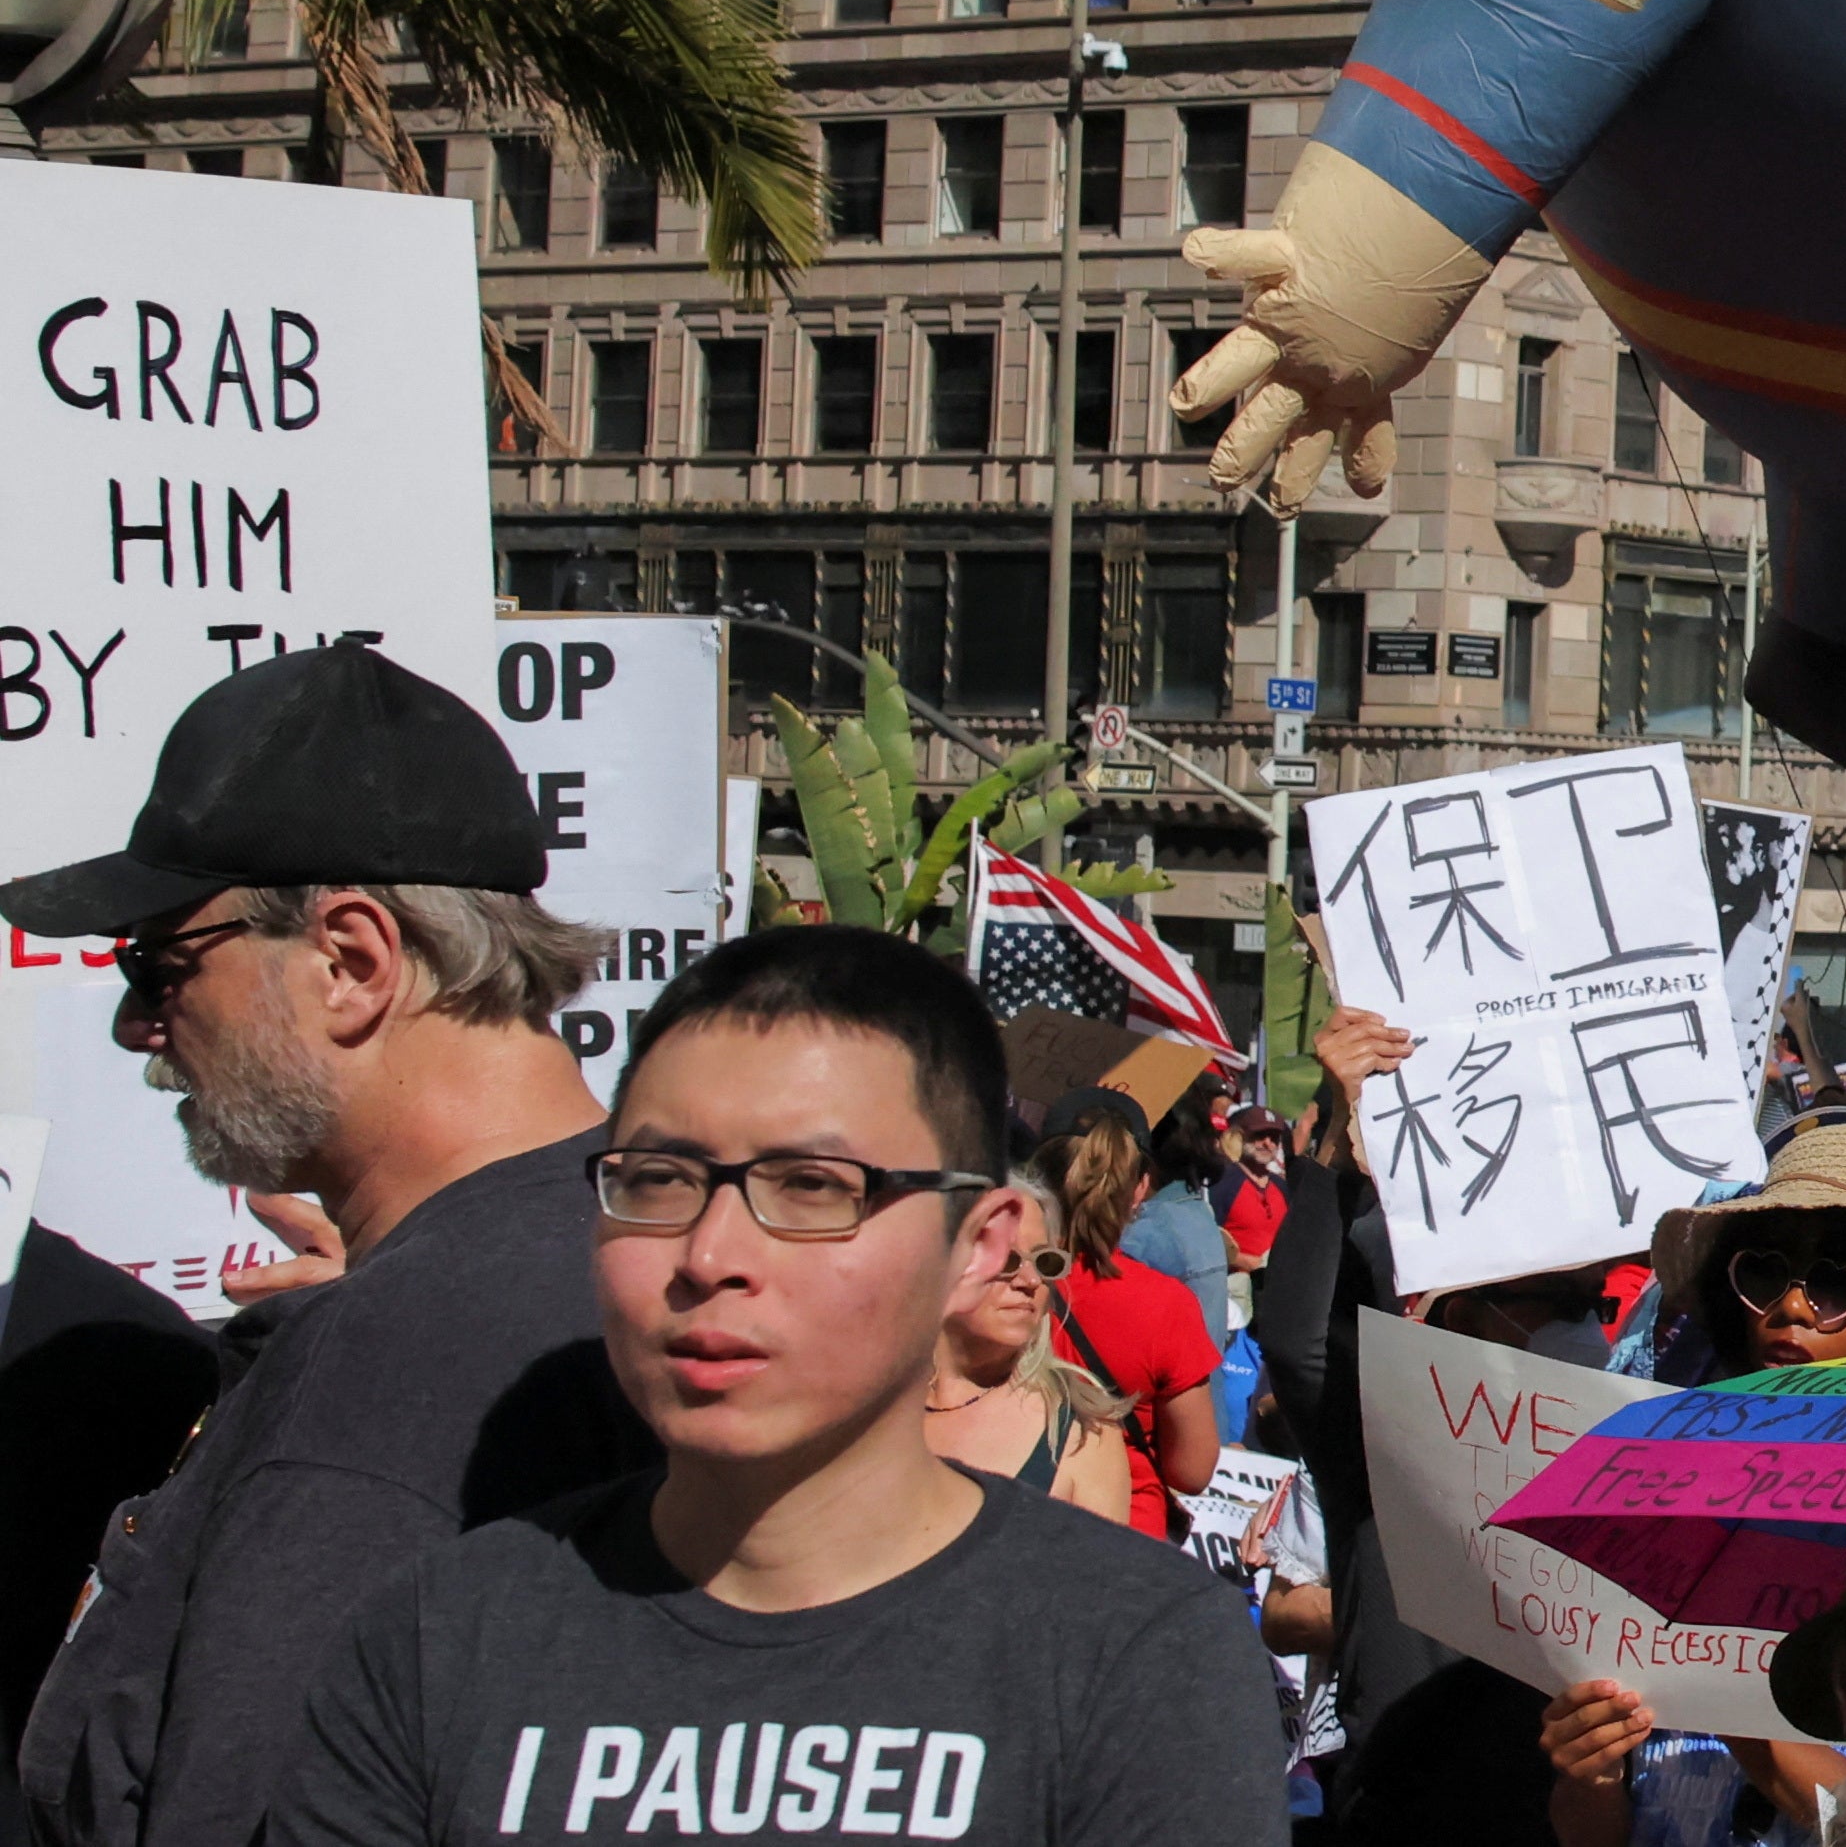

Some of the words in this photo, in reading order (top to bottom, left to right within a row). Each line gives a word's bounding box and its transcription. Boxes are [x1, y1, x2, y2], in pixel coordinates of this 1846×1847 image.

[38, 296, 320, 432] GRAB
[108, 477, 291, 593] HIM
[0, 625, 127, 741] BY
[1325, 764, 1719, 1004] 保卫
[1476, 991, 1557, 1020] PROTECT
[1565, 973, 1709, 1010] IMMIGRANTS
[1372, 999, 1739, 1234] 移民
[1429, 1361, 1578, 1458] WE
[1645, 1392, 1778, 1441] PBS
[1571, 1445, 1699, 1509] Free
[1460, 1524, 1517, 1580] WE
[1492, 1581, 1600, 1654] LOUSY
[500, 1726, 545, 1834] I
[564, 1722, 987, 1840] PAUSED
